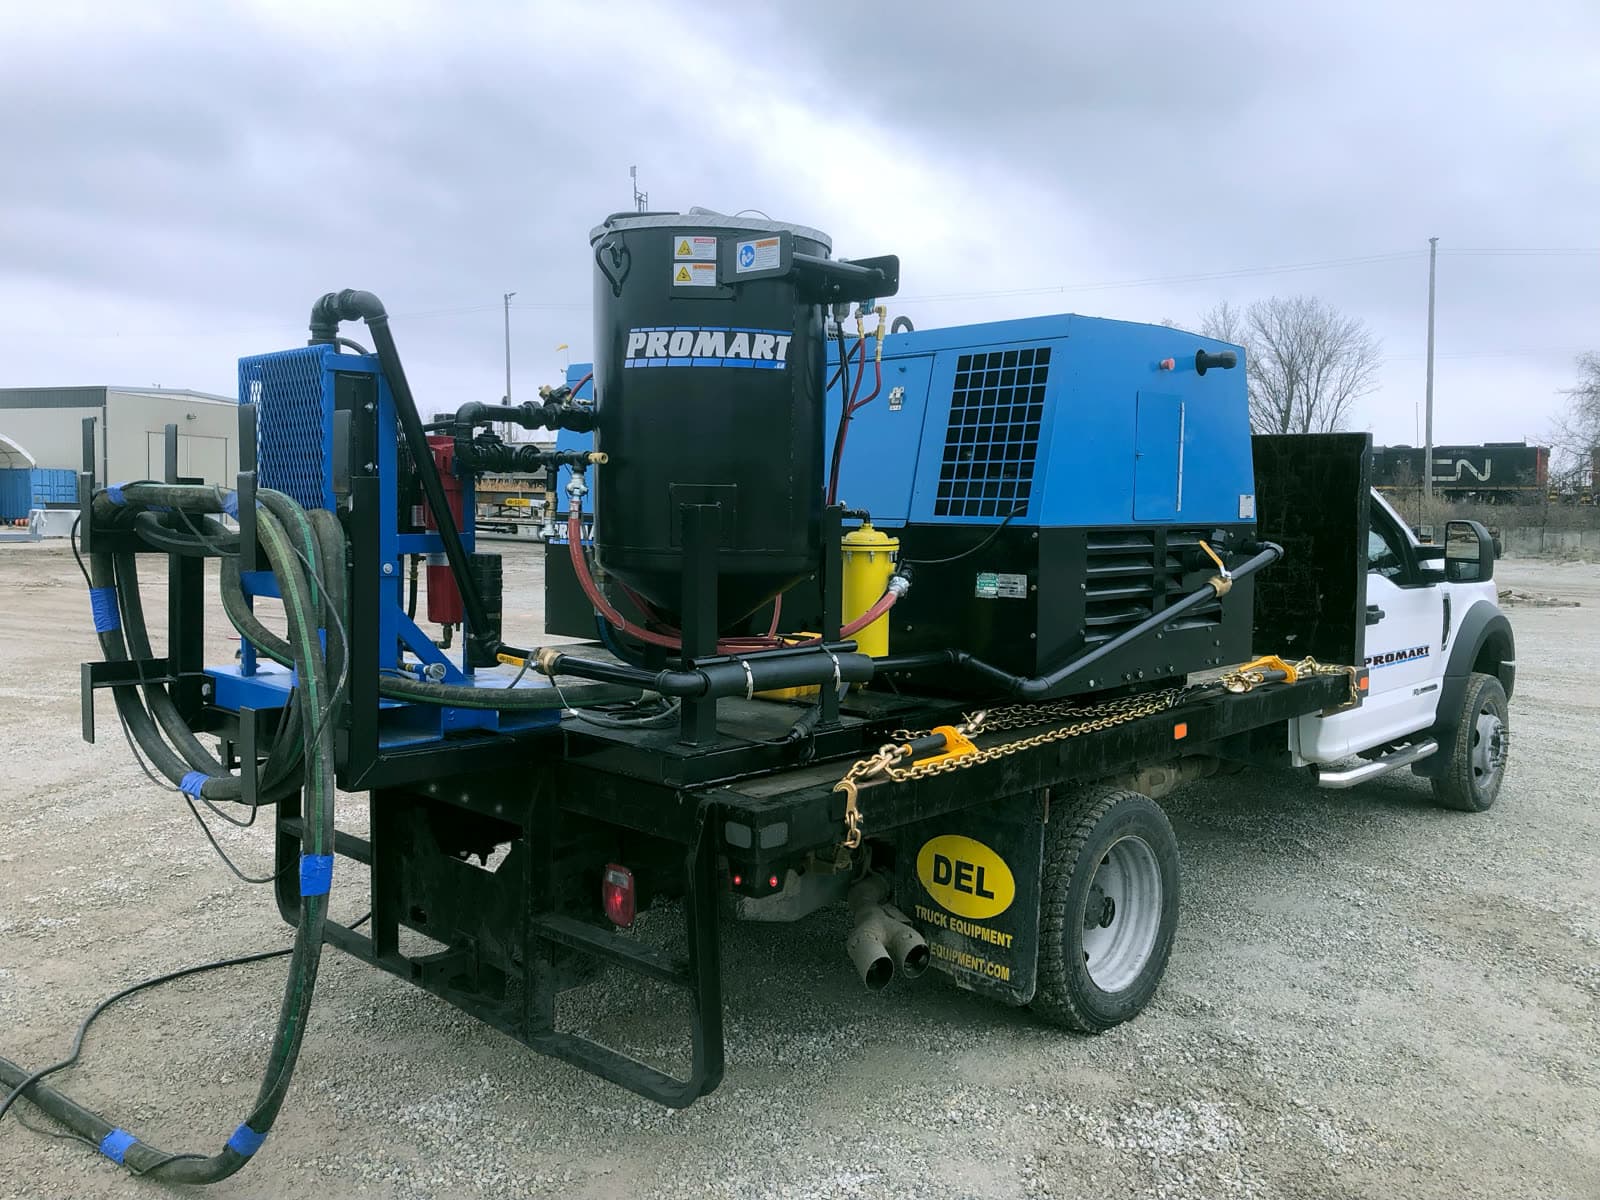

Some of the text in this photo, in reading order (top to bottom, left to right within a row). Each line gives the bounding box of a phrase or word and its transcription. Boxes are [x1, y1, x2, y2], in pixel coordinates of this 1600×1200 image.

[625, 331, 792, 361] PROMART
[1363, 646, 1430, 668] PROMART
[933, 853, 995, 900] DEL
[914, 904, 1014, 949] TRUCK EQUIPMENT
